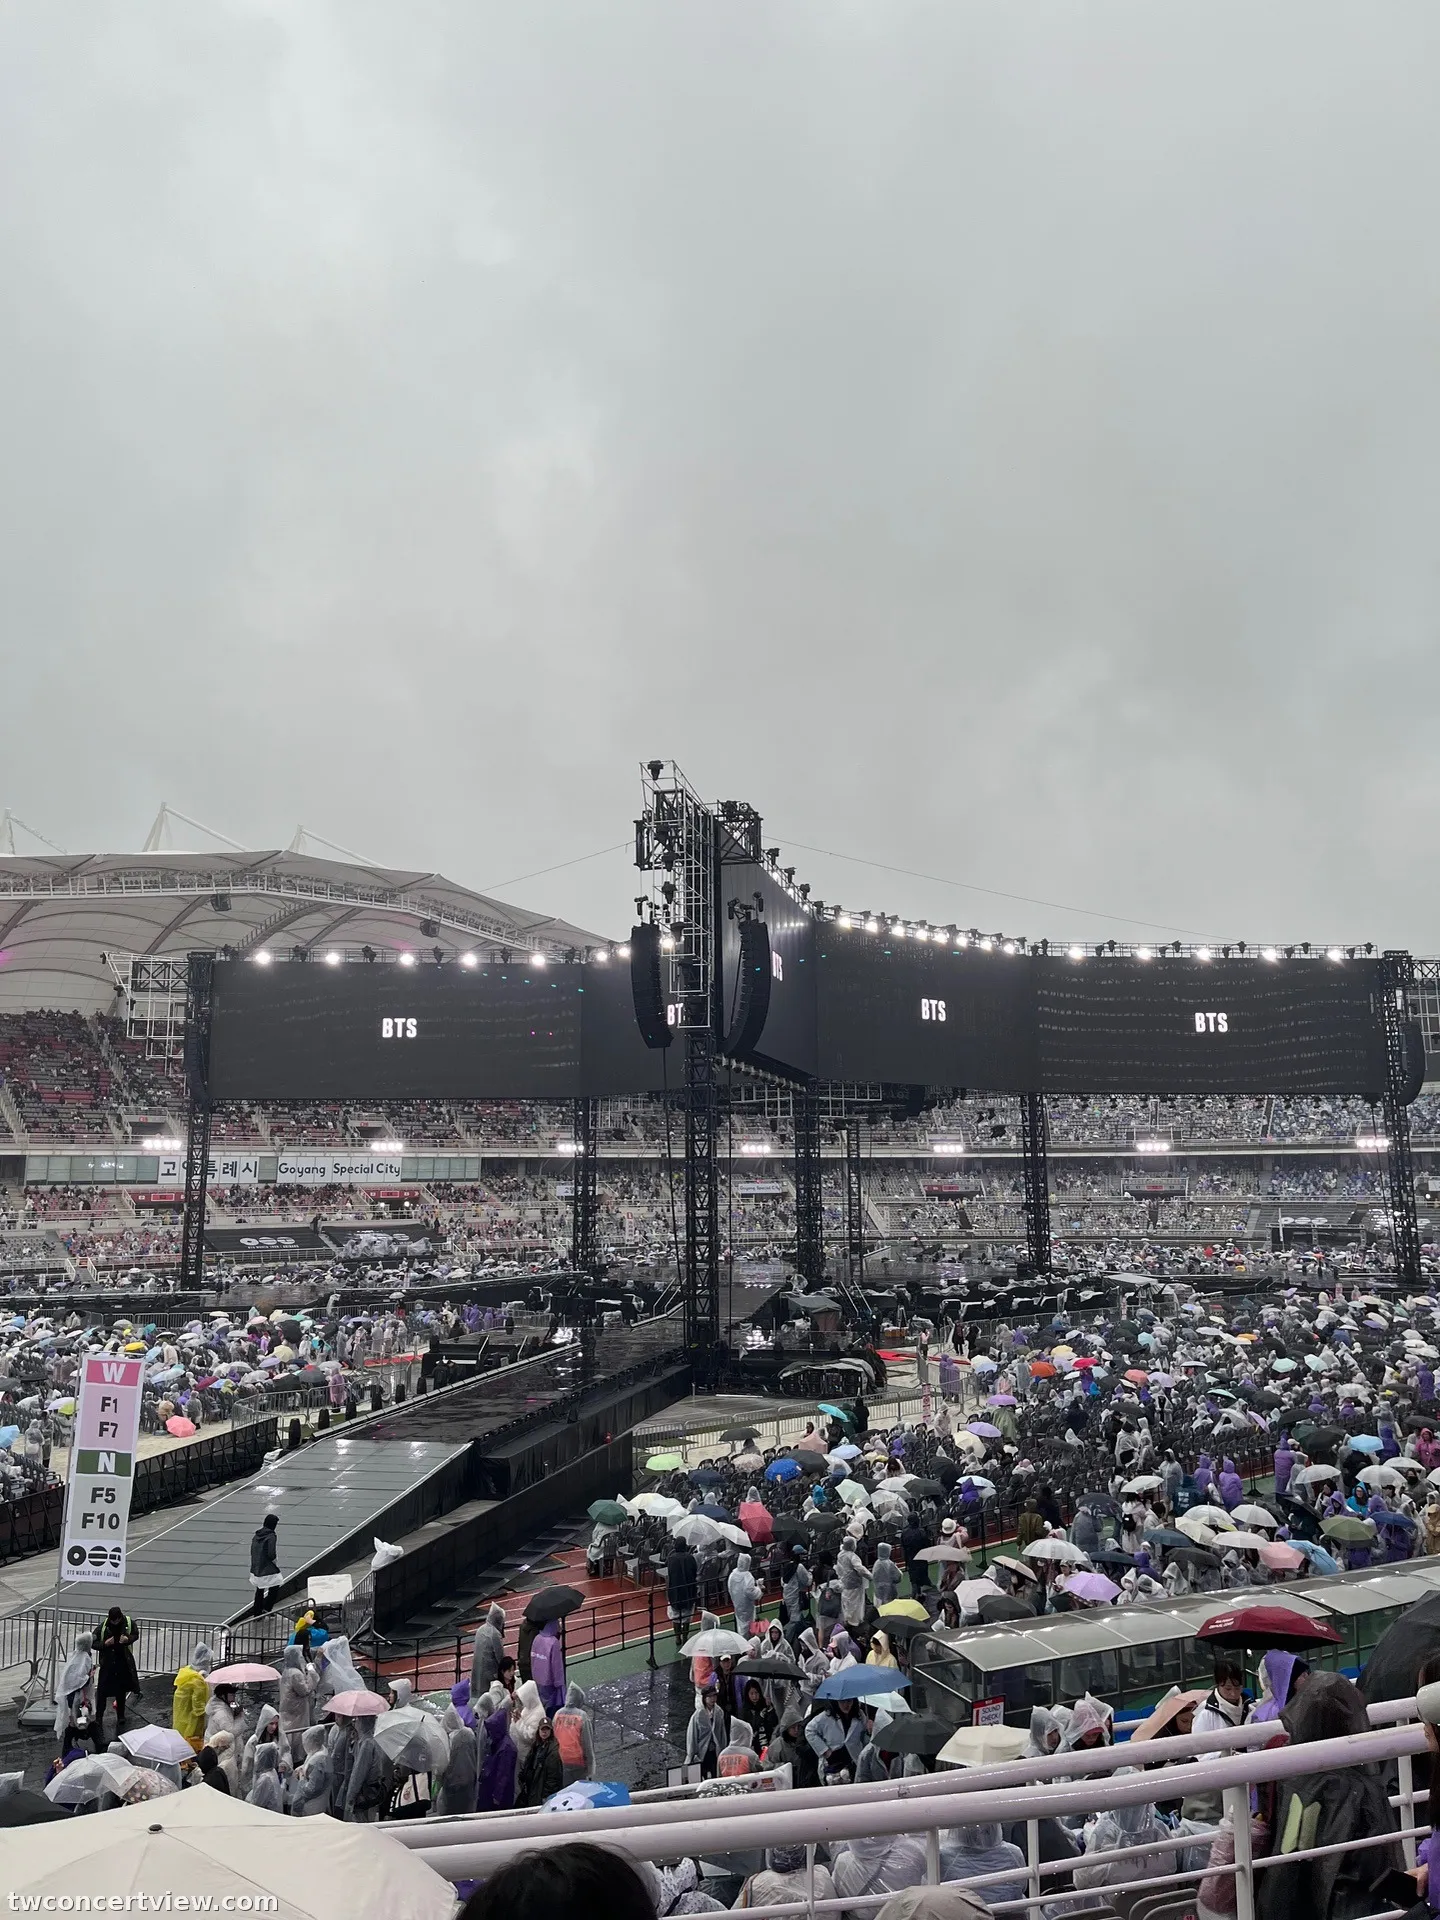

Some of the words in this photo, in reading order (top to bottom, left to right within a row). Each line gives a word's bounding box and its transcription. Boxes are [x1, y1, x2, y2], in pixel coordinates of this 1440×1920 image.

[667, 1003, 684, 1025] BT
[921, 998, 946, 1021] BTS
[382, 1017, 417, 1038] BTS
[1194, 1012, 1228, 1033] BTS
[278, 1162, 326, 1177] Goyang
[333, 1162, 374, 1176] Special
[376, 1162, 401, 1177] City
[102, 1362, 126, 1384] W
[100, 1396, 118, 1413] F1
[98, 1421, 119, 1438] F7
[97, 1452, 116, 1474] N
[90, 1487, 116, 1504] F5
[81, 1513, 120, 1530] F10
[981, 1713, 999, 1723] CHECK
[982, 1704, 1001, 1715] SOUND
